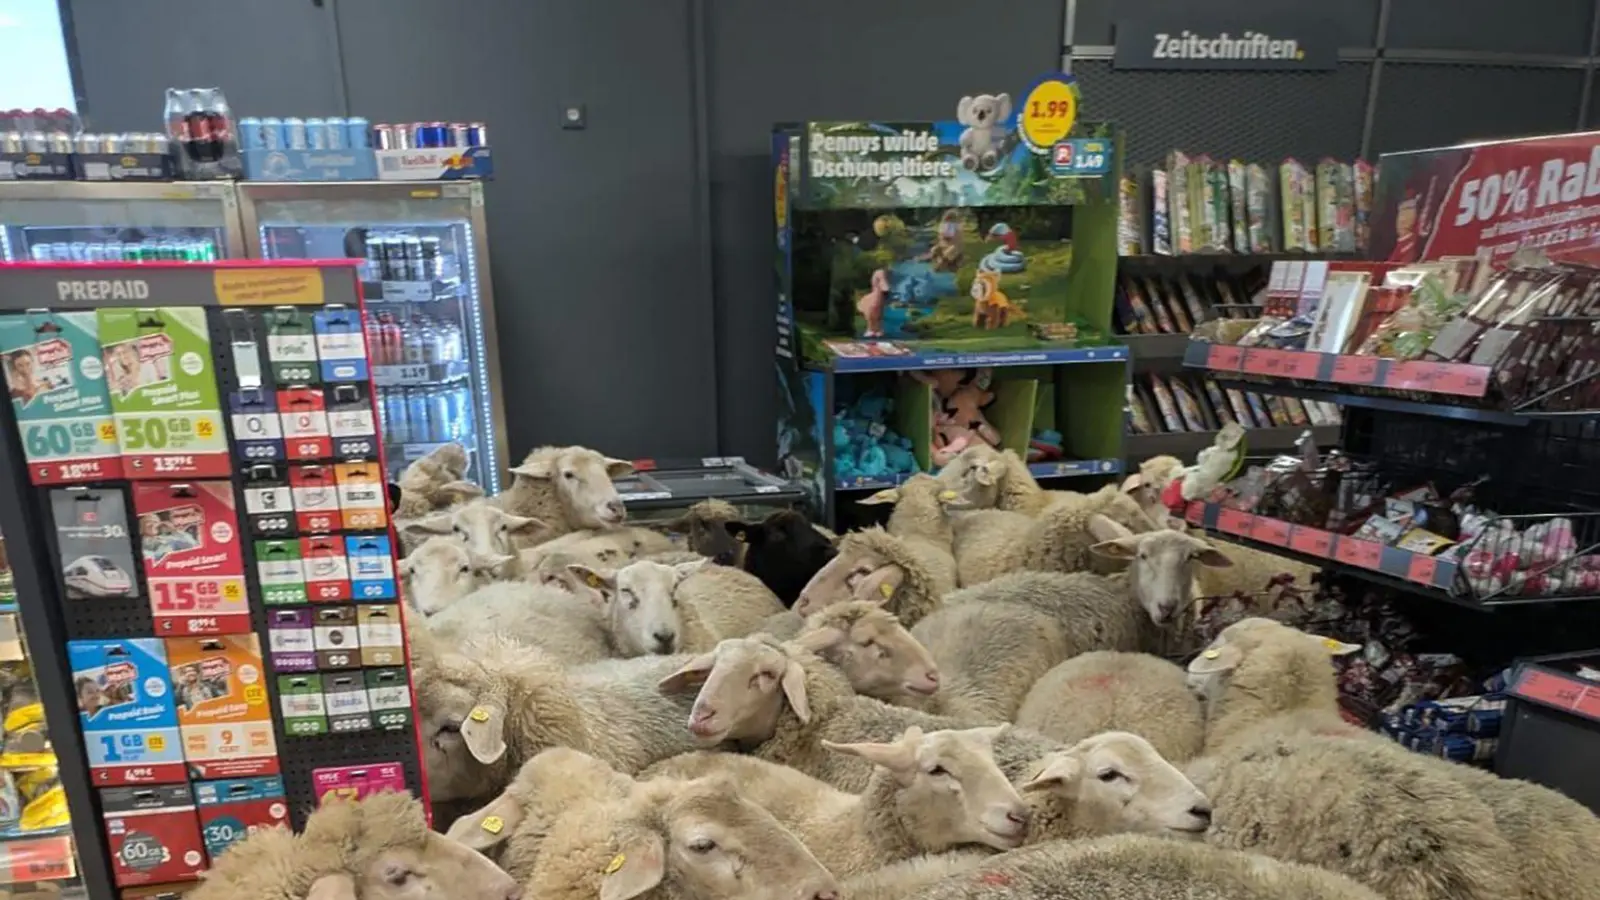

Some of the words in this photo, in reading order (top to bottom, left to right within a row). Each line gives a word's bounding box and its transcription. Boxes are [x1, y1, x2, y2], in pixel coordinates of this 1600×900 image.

[1031, 100, 1068, 118] 1.99
[811, 132, 881, 155] Pennys
[883, 129, 938, 152] wilde
[1074, 154, 1104, 169] 1.49
[1455, 166, 1531, 226] 50%
[57, 280, 149, 300] PREPAID
[26, 424, 71, 456] 60
[70, 422, 95, 437] GB
[122, 417, 168, 449] 30
[167, 418, 191, 432] GB
[154, 582, 196, 611] 15
[197, 581, 218, 595] GB
[100, 735, 121, 761] 1
[121, 734, 142, 746] GB
[221, 729, 233, 745] 9
[209, 825, 233, 841] 30
[123, 842, 148, 860] 60
